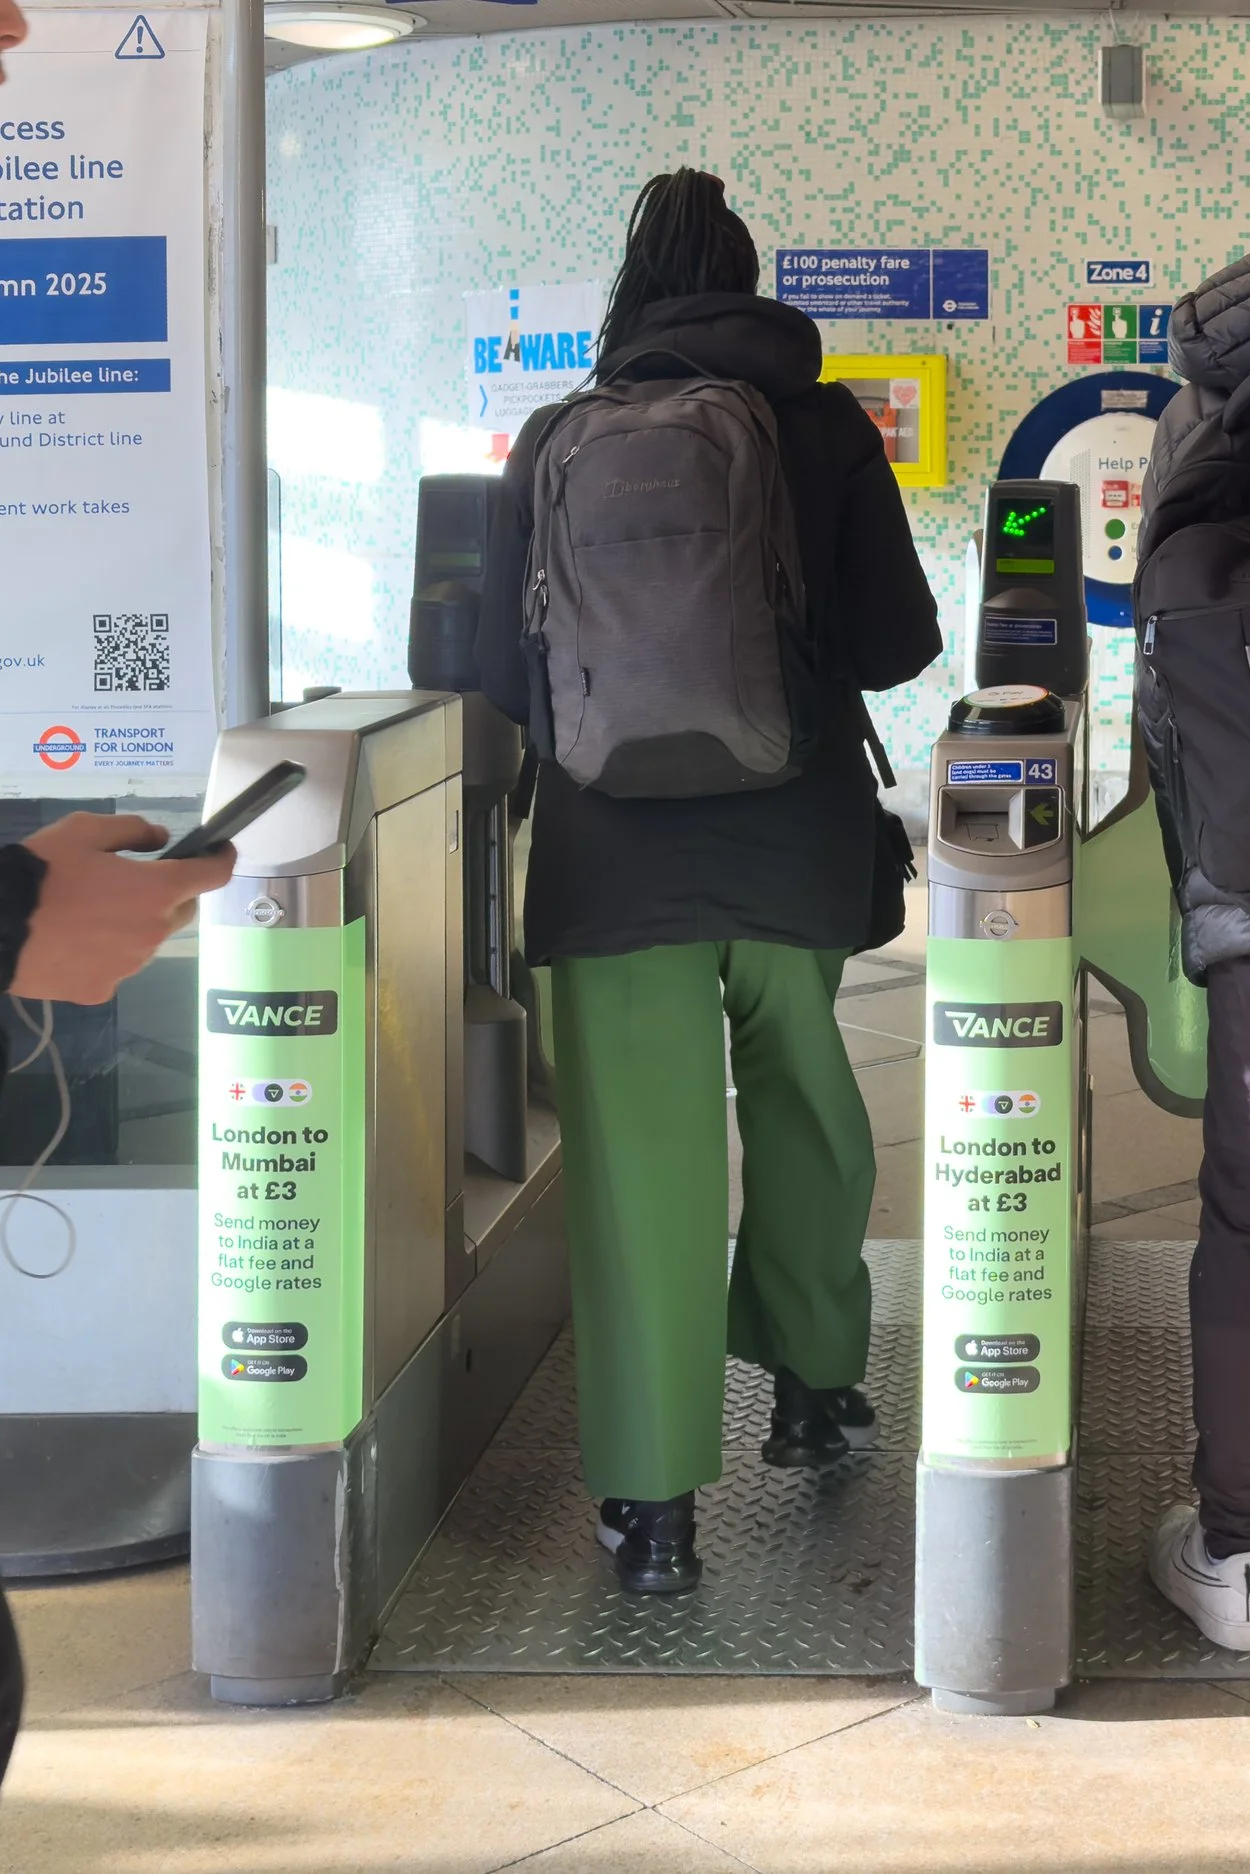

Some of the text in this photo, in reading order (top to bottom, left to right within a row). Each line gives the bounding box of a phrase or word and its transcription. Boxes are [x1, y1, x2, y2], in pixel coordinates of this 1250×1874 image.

[70, 154, 124, 179] line
[782, 255, 910, 271] £100 penalty fare
[782, 273, 890, 288] or prosecution
[1089, 264, 1148, 281] Zone 4
[45, 272, 107, 296] 2025
[25, 368, 93, 384] Jubilee
[98, 367, 139, 382] line:
[10, 411, 42, 425] line
[48, 411, 66, 425] at
[39, 432, 104, 447] District
[110, 431, 143, 445] line
[1098, 457, 1134, 472] Help
[32, 500, 77, 515] work
[83, 499, 130, 514] takes
[94, 728, 165, 738] TRANSPORT
[35, 744, 85, 752] UNDERGROUND
[94, 742, 174, 752] FOR LONDON
[1028, 763, 1053, 779] 43
[216, 998, 324, 1026] VANCE
[944, 1010, 1050, 1039] VANCE
[212, 1123, 329, 1144] London to
[940, 1135, 1056, 1157] London to
[222, 1151, 316, 1172] Mumbai
[935, 1162, 1062, 1187] Hyderabad
[236, 1181, 297, 1200] at £3
[968, 1192, 1027, 1212] at £3
[214, 1213, 320, 1233] Send money
[218, 1235, 314, 1250] to India at a
[943, 1225, 1050, 1244] Send money
[218, 1254, 314, 1270] flat fee and
[949, 1248, 1045, 1262] to India at a
[211, 1272, 322, 1293] Google rates
[949, 1266, 1044, 1283] flat fee and
[941, 1285, 1052, 1305] Google rates
[246, 1333, 295, 1345] App Store
[980, 1345, 1029, 1357] App Store
[247, 1365, 295, 1377] Google Play
[981, 1377, 1029, 1389] Google Play
